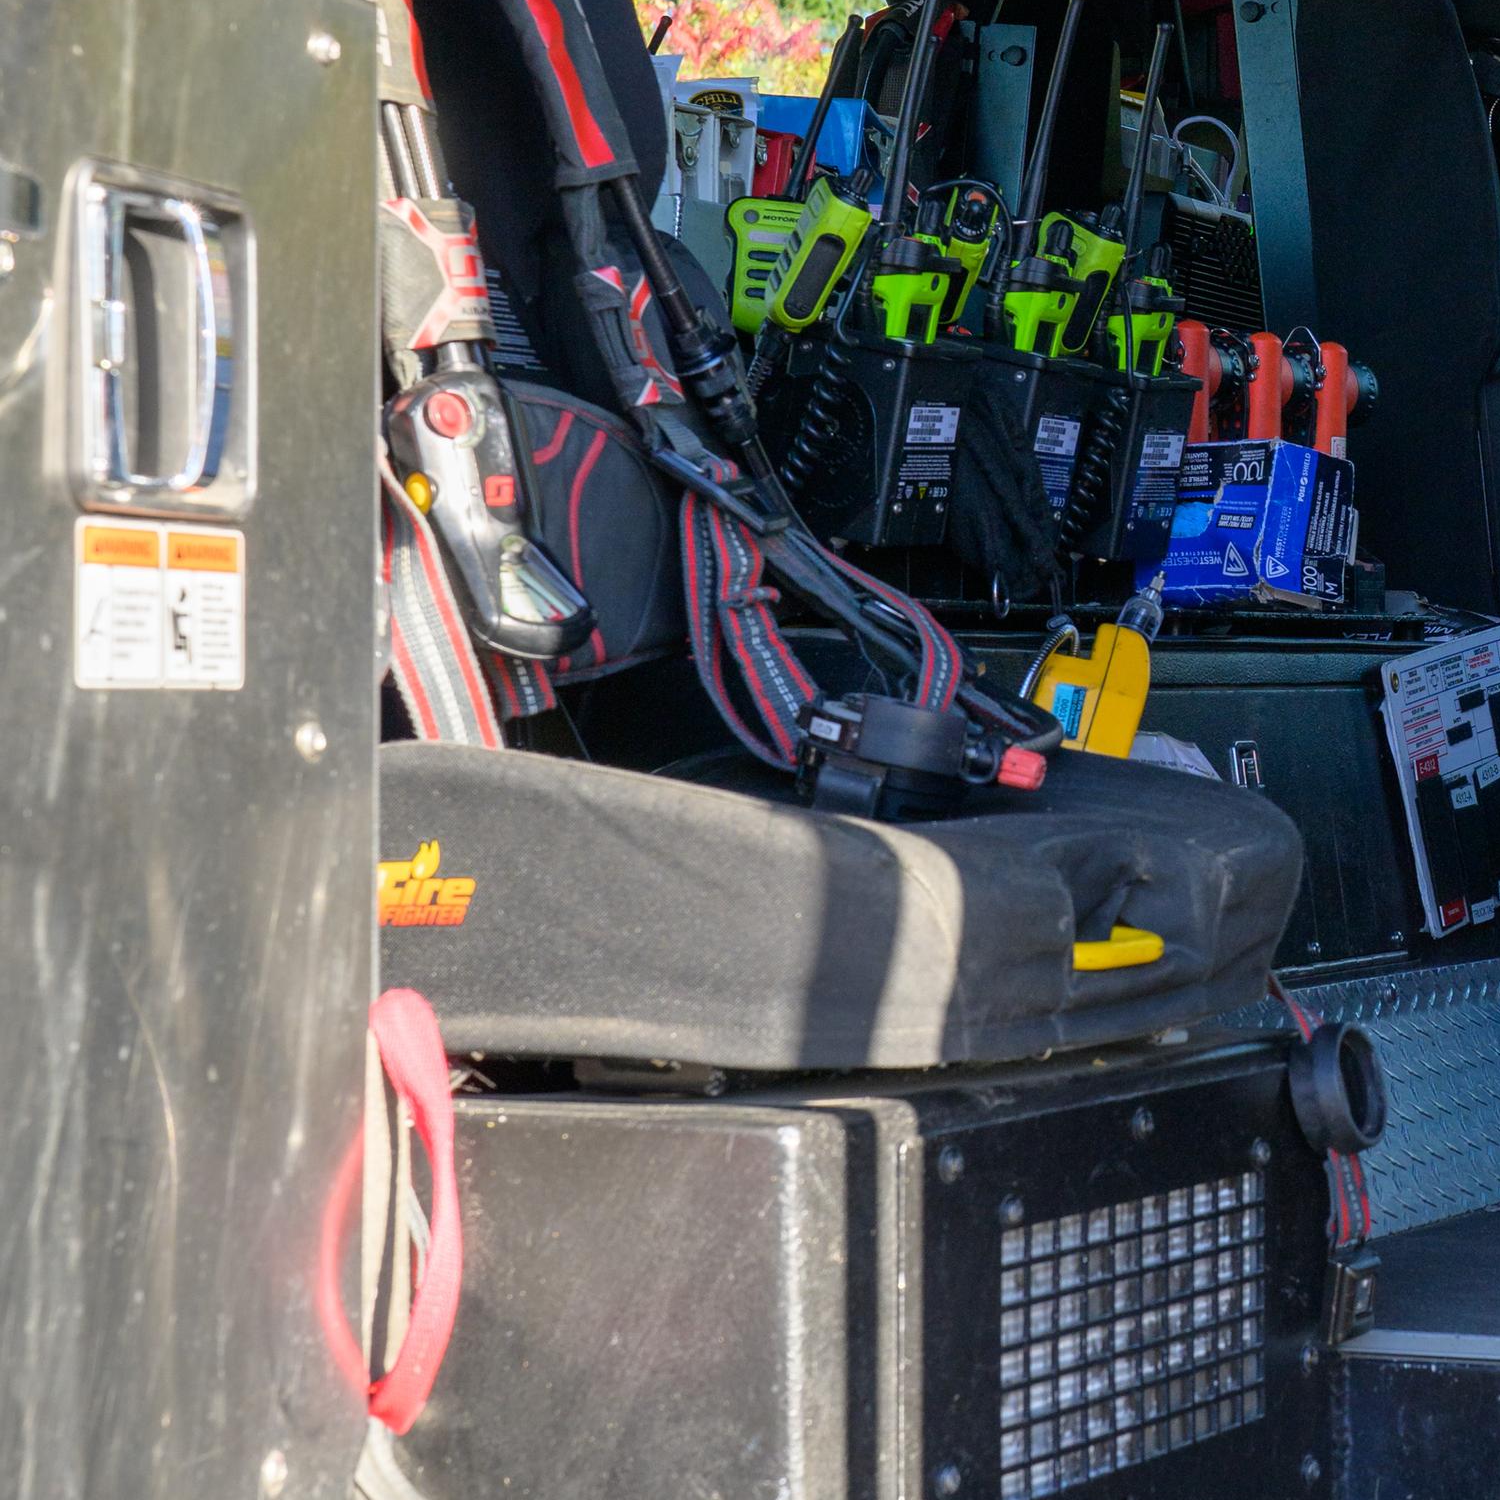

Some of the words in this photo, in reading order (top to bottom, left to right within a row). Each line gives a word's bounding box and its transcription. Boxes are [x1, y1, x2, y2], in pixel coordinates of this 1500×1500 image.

[696, 93, 738, 106] CHILI
[763, 214, 799, 223] MOTOR
[1302, 452, 1311, 476] SHIELD
[1161, 554, 1222, 567] WESTCHESTER
[1303, 565, 1318, 591] 100
[1325, 582, 1338, 596] M
[377, 842, 477, 905] Fire
[380, 905, 468, 927] FIGHTER
